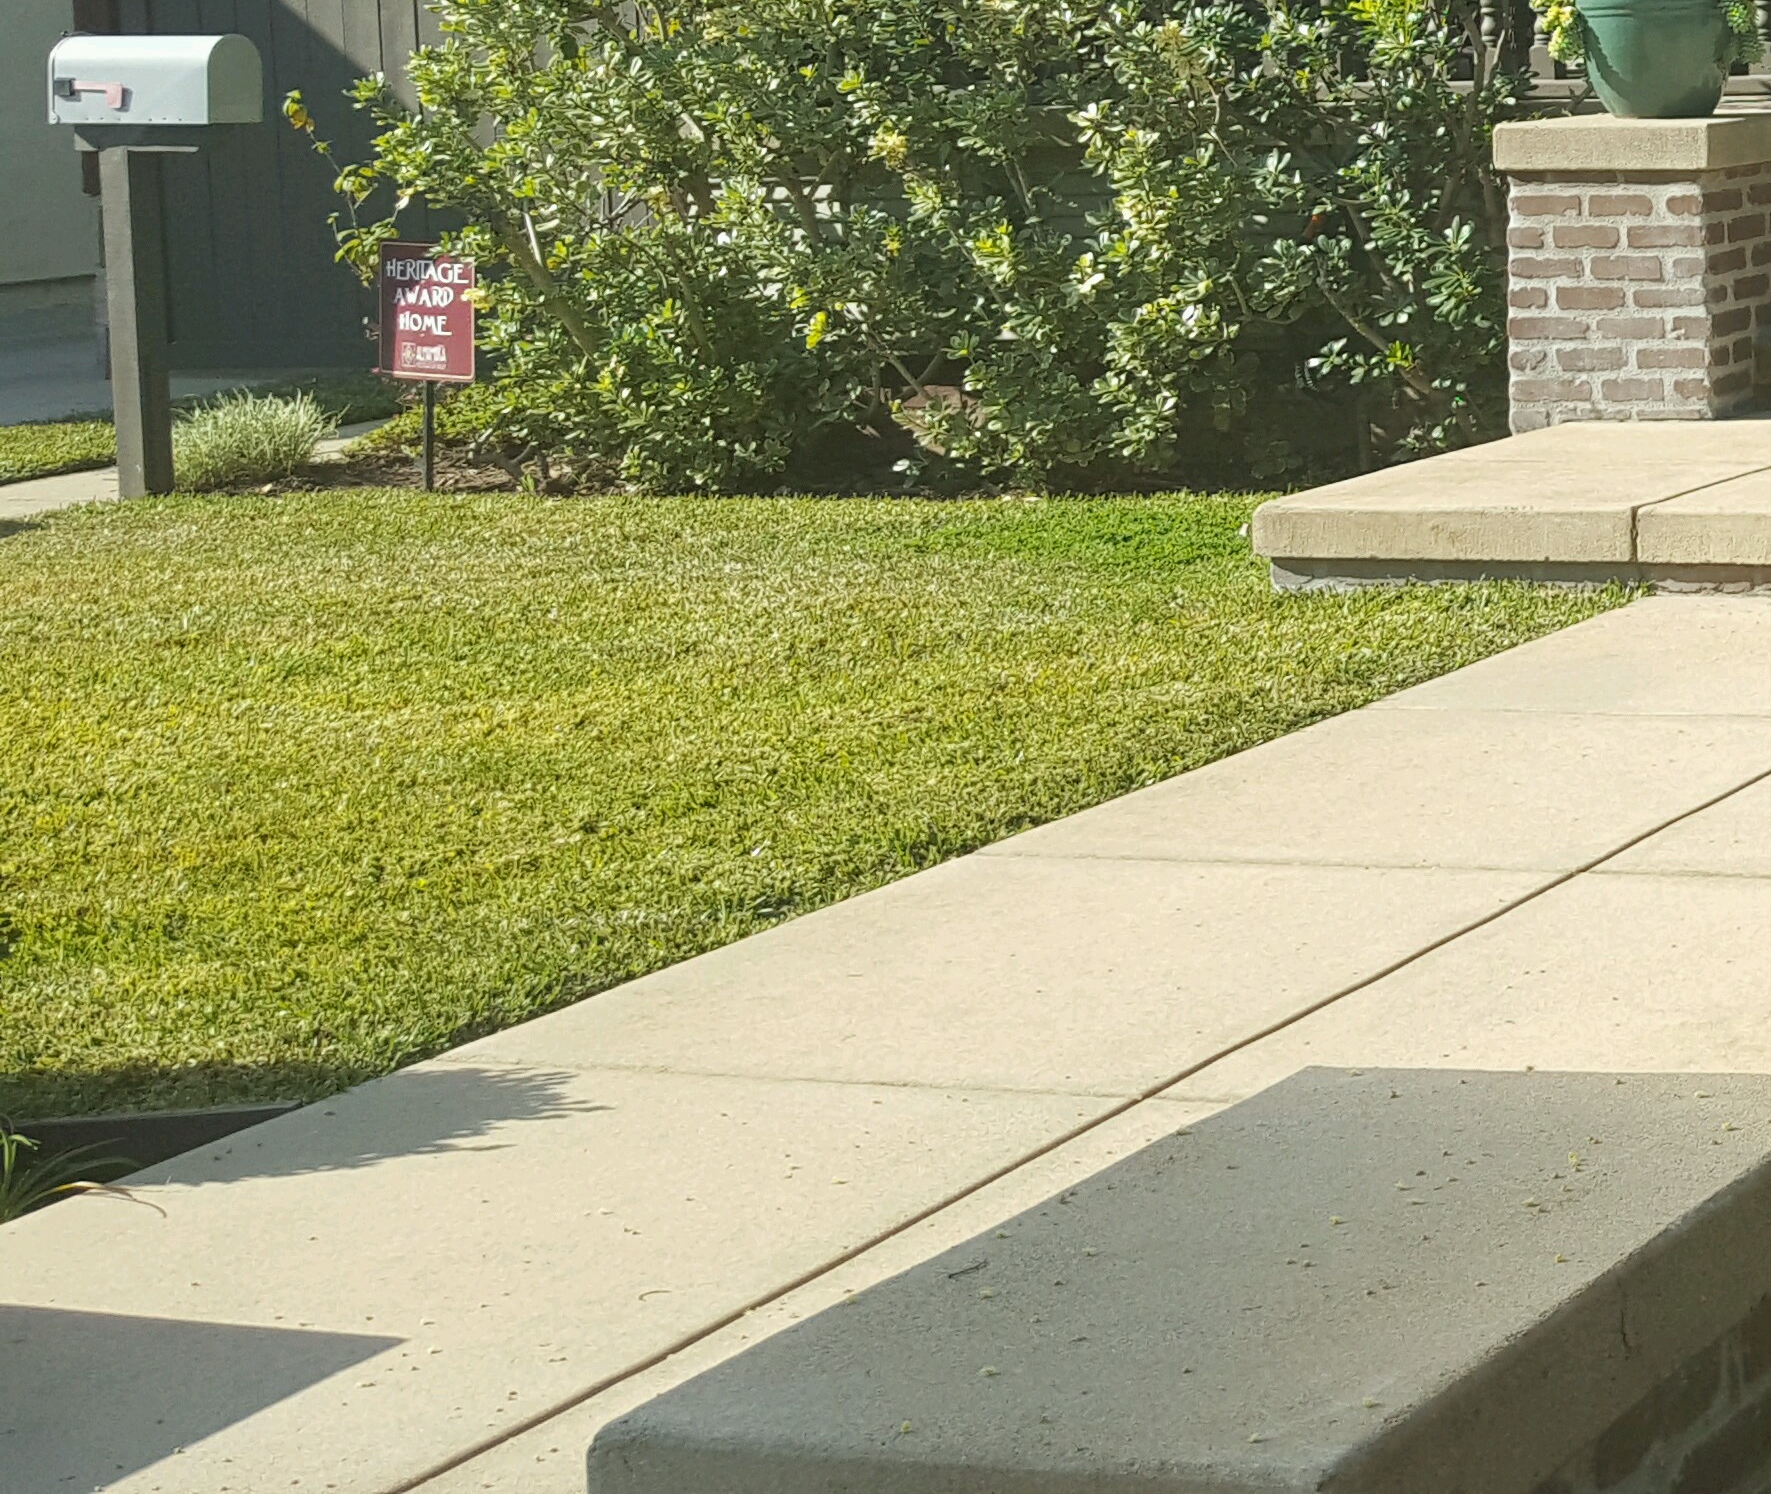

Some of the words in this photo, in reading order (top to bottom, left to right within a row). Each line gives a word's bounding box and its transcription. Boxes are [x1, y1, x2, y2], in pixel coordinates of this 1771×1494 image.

[386, 258, 469, 284] HERITAGE
[393, 286, 454, 308] AWARD
[398, 312, 452, 335] HOME
